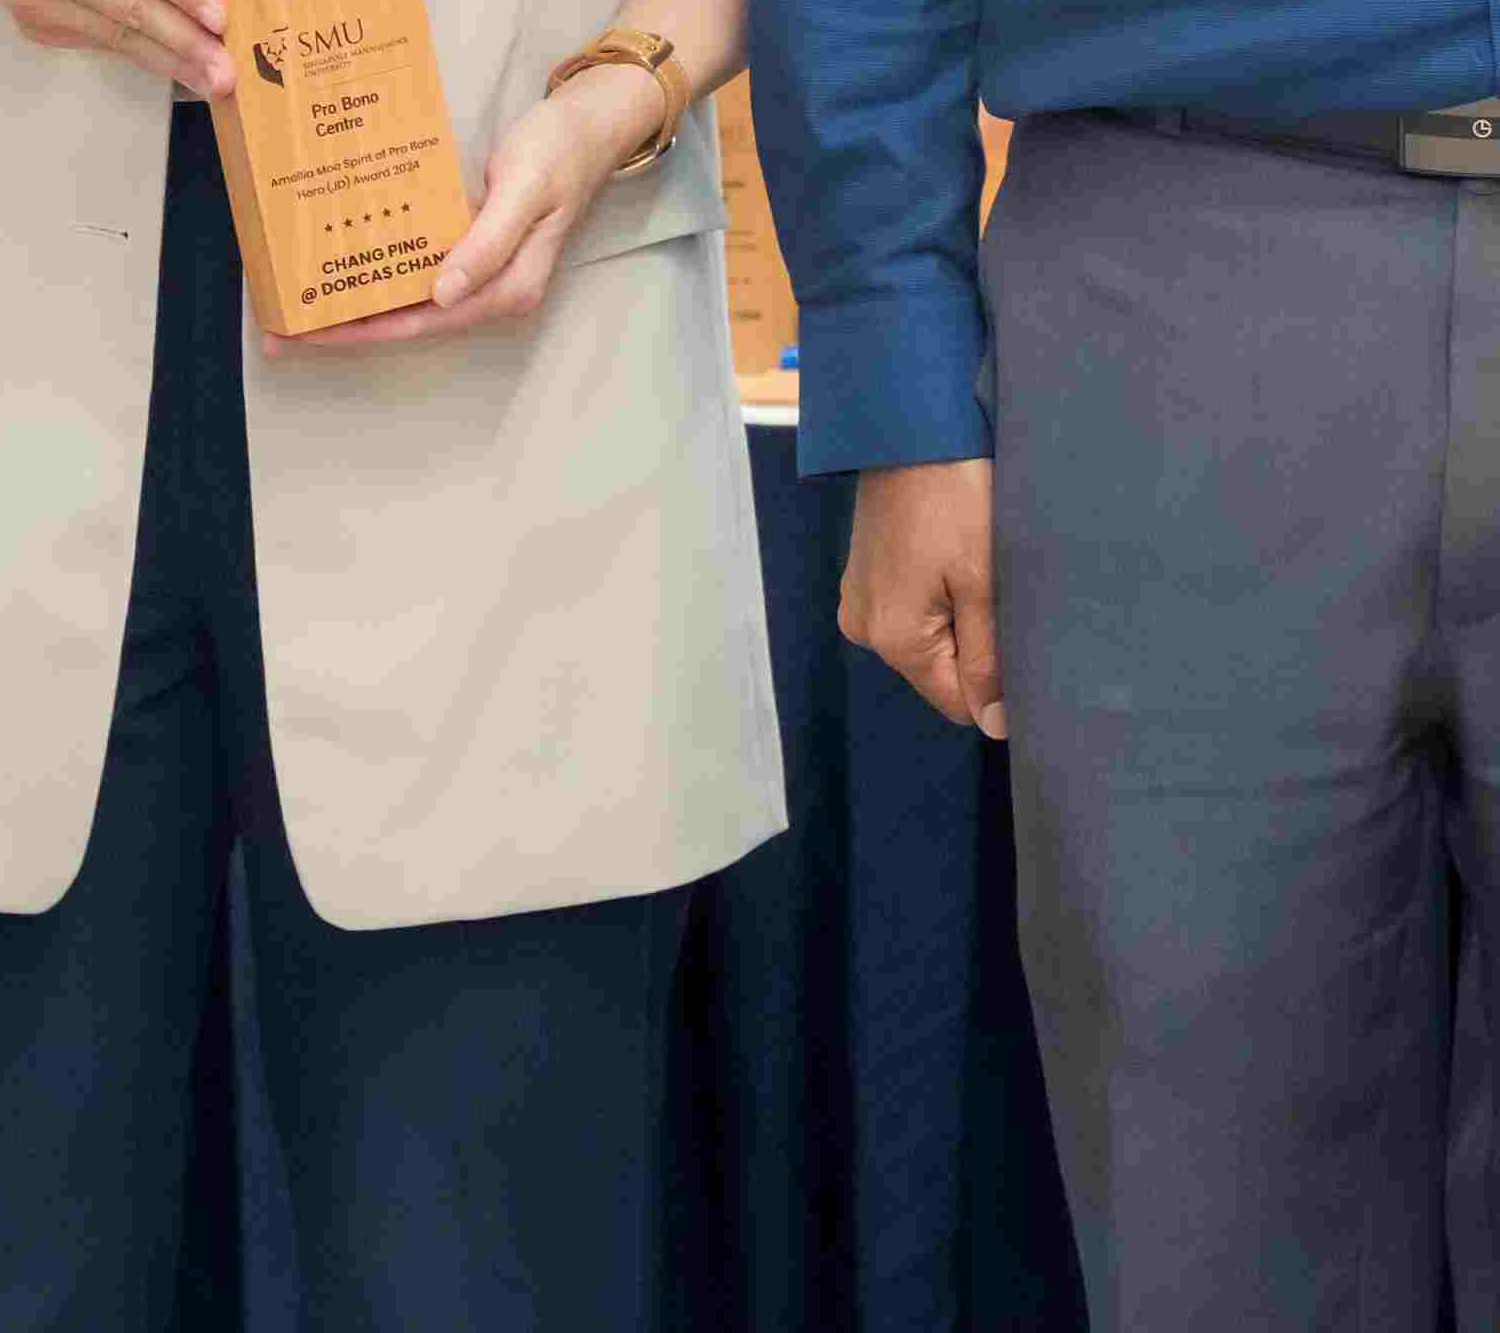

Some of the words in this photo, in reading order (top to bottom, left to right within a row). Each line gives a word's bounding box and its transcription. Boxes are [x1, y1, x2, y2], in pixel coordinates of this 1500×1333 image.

[298, 18, 364, 57] SMU
[311, 102, 337, 119] Pro
[341, 92, 379, 111] Bono
[315, 116, 364, 137] Centre
[353, 167, 390, 185] Award
[322, 247, 384, 276] CHANG
[388, 236, 429, 258] PING
[301, 286, 318, 304] @
[321, 265, 393, 296] DORCAS
[396, 250, 451, 276] CHAN
